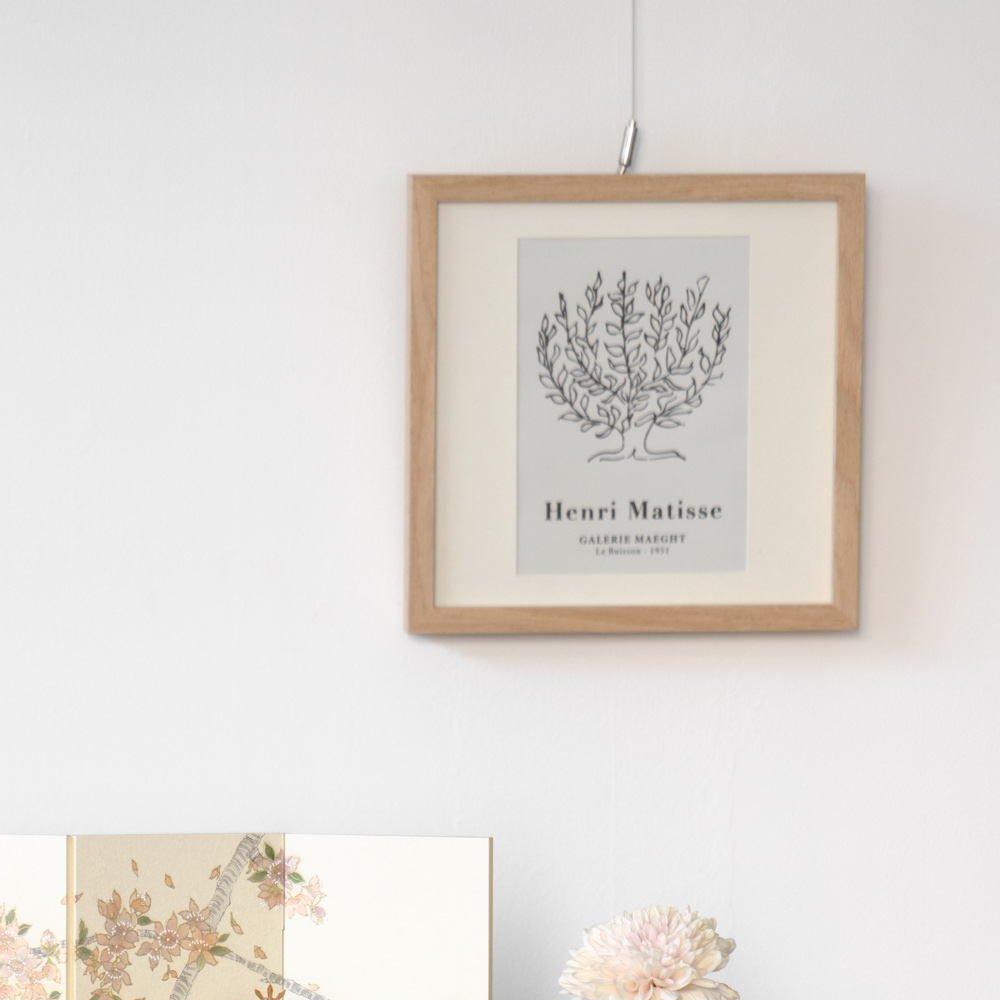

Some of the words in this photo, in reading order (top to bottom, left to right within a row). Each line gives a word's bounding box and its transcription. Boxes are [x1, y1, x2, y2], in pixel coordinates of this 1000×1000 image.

[545, 501, 616, 521] Henri
[628, 499, 722, 520] Matisse
[579, 535, 631, 545] GALERIE
[634, 534, 687, 544] MAEGHT
[649, 547, 670, 556] 1951
